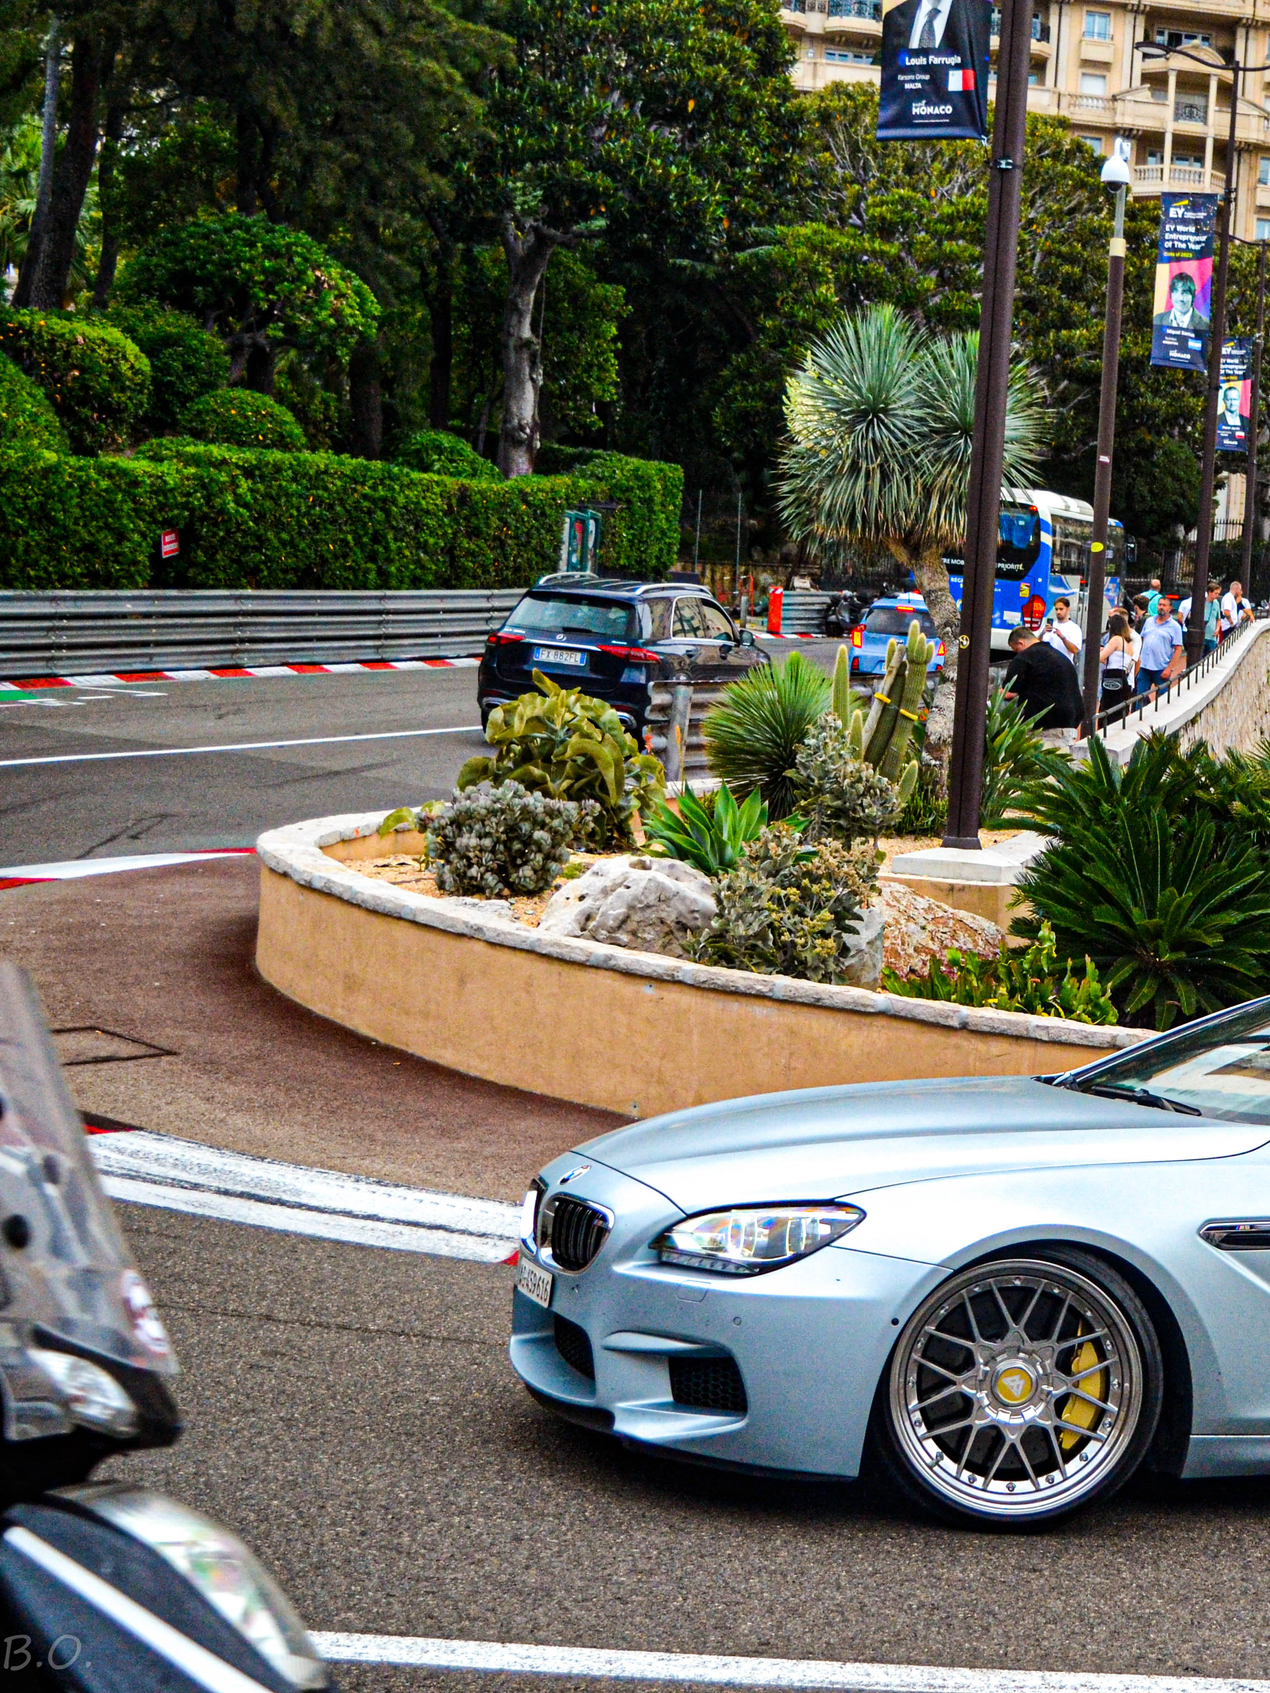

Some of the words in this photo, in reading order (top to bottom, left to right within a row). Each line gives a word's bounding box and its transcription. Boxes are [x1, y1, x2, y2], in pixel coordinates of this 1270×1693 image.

[906, 56, 927, 65] Louis
[929, 55, 961, 66] Farrugia
[911, 104, 953, 115] MONACO
[1169, 207, 1185, 218] EY
[1176, 225, 1195, 233] World
[1164, 233, 1207, 241] Entrepreneur
[1164, 241, 1173, 249] Of
[1173, 241, 1187, 249] The
[1221, 347, 1231, 355] EY
[540, 650, 551, 659] FX
[553, 651, 579, 663] 882FL
